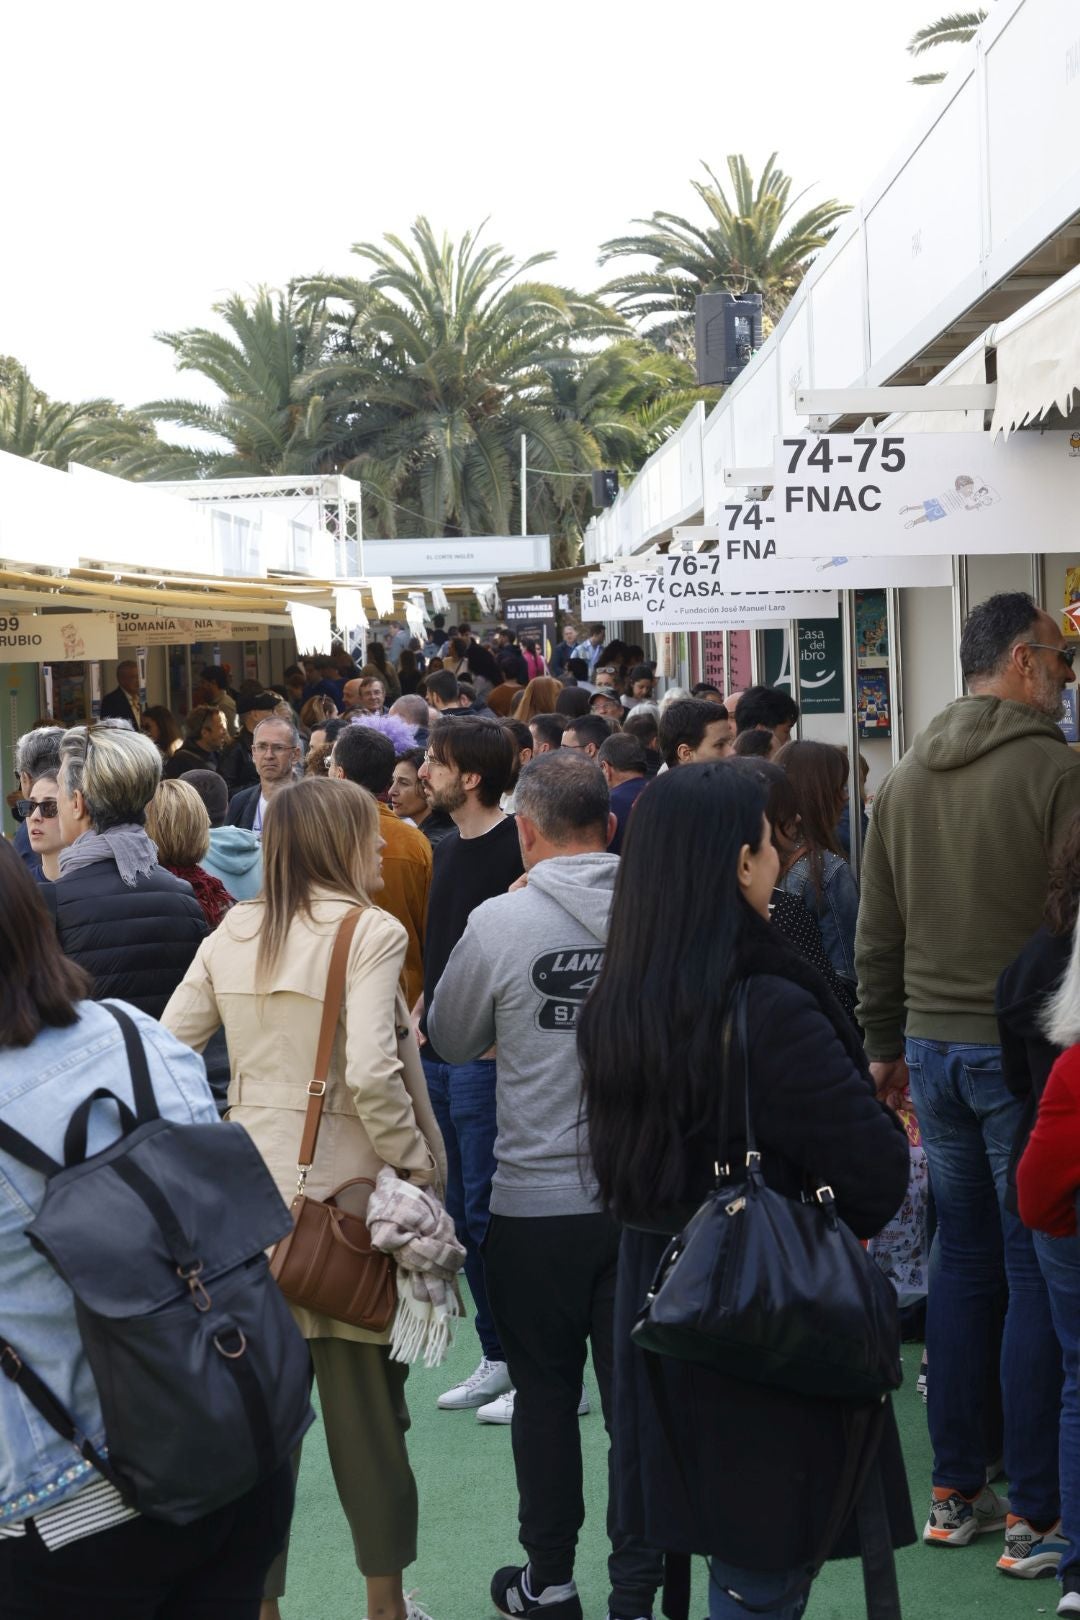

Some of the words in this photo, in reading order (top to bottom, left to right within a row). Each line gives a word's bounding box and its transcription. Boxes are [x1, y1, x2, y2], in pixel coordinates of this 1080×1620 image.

[783, 437, 906, 473] 74-75
[785, 484, 882, 512] FNAC
[669, 581, 724, 598] CASA
[614, 591, 643, 602] ABA
[680, 606, 718, 615] Fundación
[739, 605, 768, 613] Manuel
[0, 617, 19, 632] 99
[0, 634, 42, 646] RUBIO
[809, 640, 826, 650] del
[800, 649, 826, 661] ibro
